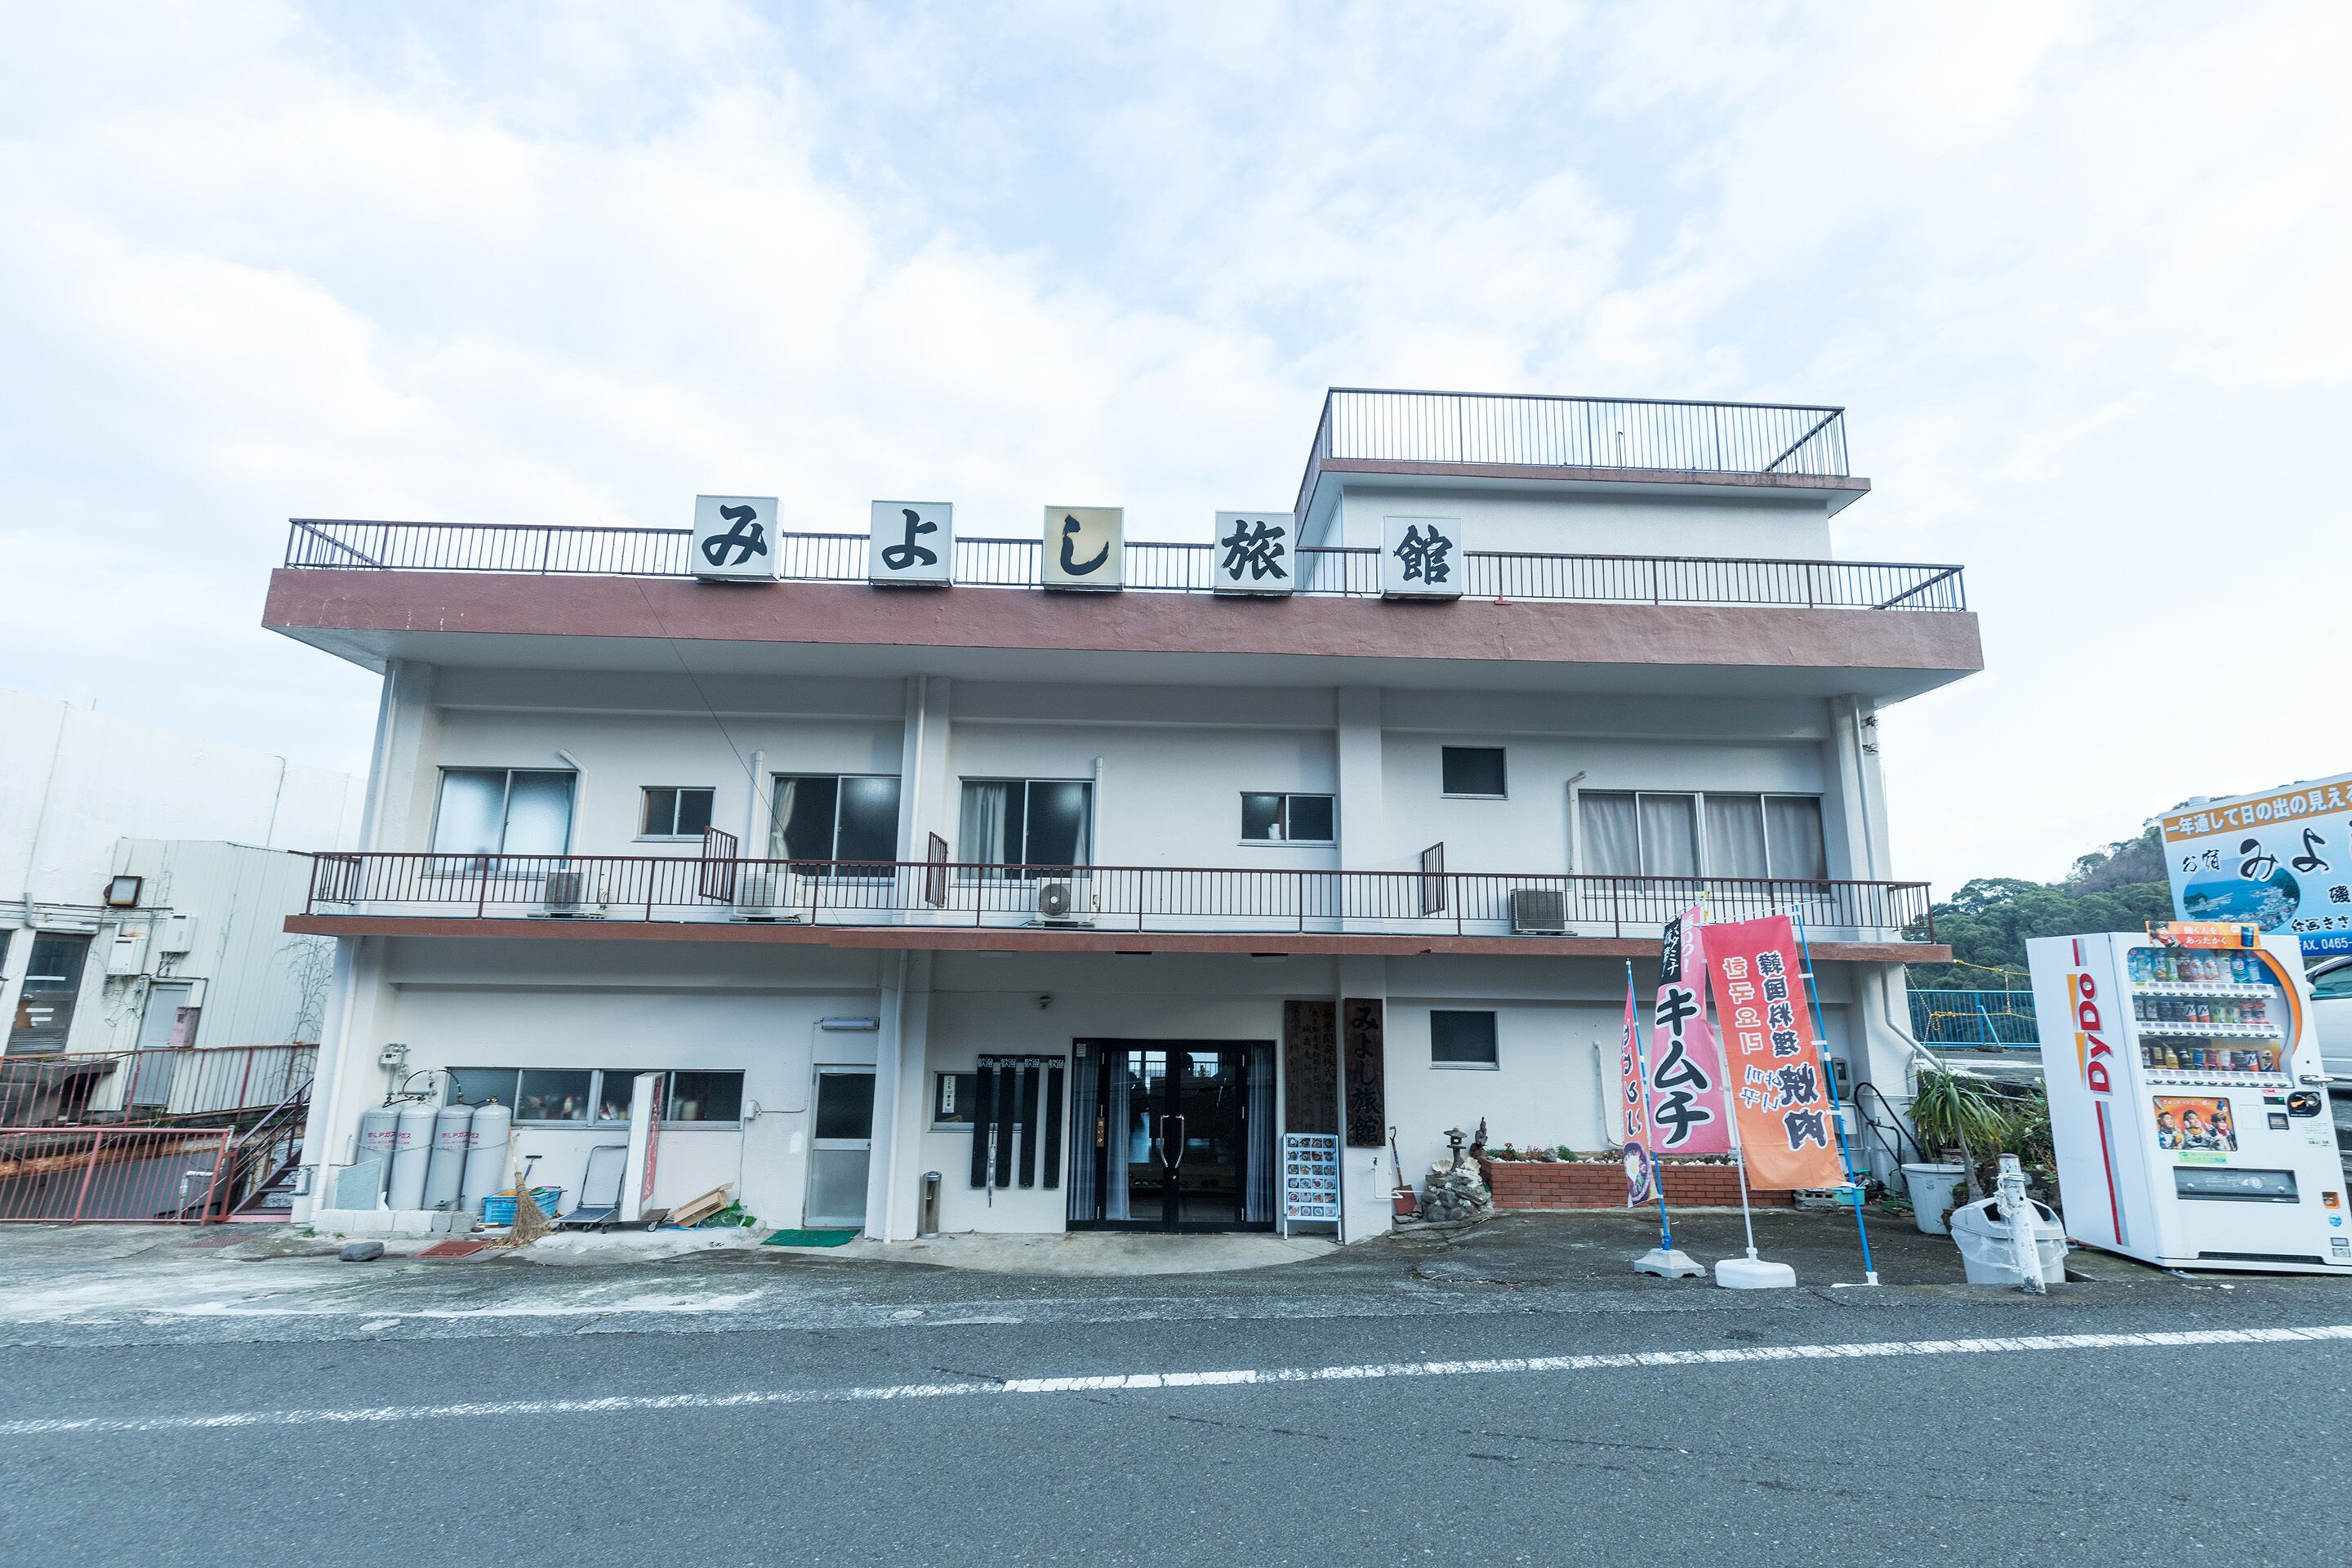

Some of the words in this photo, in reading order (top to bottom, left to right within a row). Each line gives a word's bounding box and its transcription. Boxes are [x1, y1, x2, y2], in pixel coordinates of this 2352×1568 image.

[702, 505, 1450, 585] みよし旅館
[2182, 849, 2221, 872] お宿
[2239, 820, 2352, 880] みよ
[2299, 938, 2319, 951] AX.
[1351, 1006, 1381, 1143] みよし旅館
[1655, 987, 1711, 1146] キムチ
